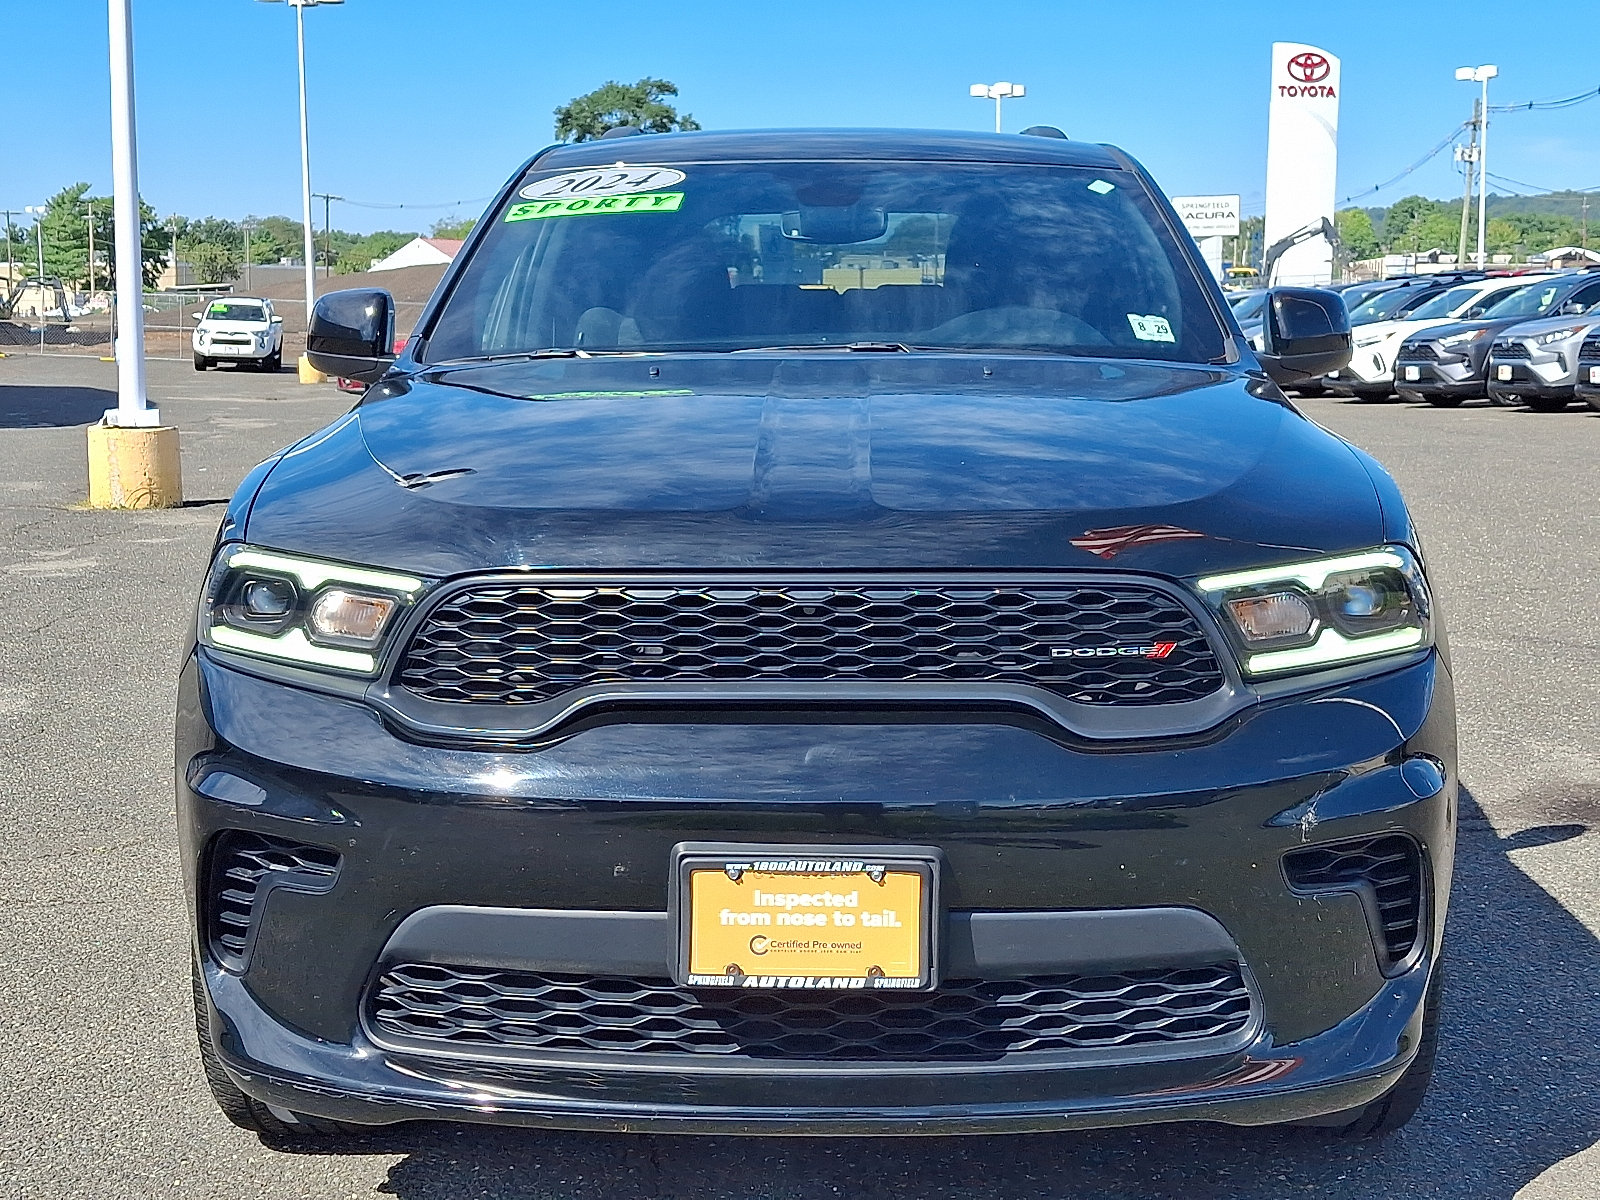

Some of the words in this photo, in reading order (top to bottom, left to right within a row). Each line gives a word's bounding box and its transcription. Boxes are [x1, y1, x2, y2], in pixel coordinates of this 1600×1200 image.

[1279, 85, 1336, 98] TOYOTA
[541, 171, 661, 197] 2024
[512, 196, 676, 216] SPORTY
[1185, 211, 1235, 220] ACURA
[1138, 321, 1146, 332] 8
[1154, 324, 1169, 334] 29
[1051, 646, 1160, 658] DODGE
[754, 889, 858, 910] Inspected
[719, 908, 771, 926] from
[776, 911, 828, 927] nose
[832, 910, 856, 927] to
[860, 909, 902, 927] tail.
[770, 940, 810, 949] Certified
[742, 975, 867, 989] AUTOLAND
